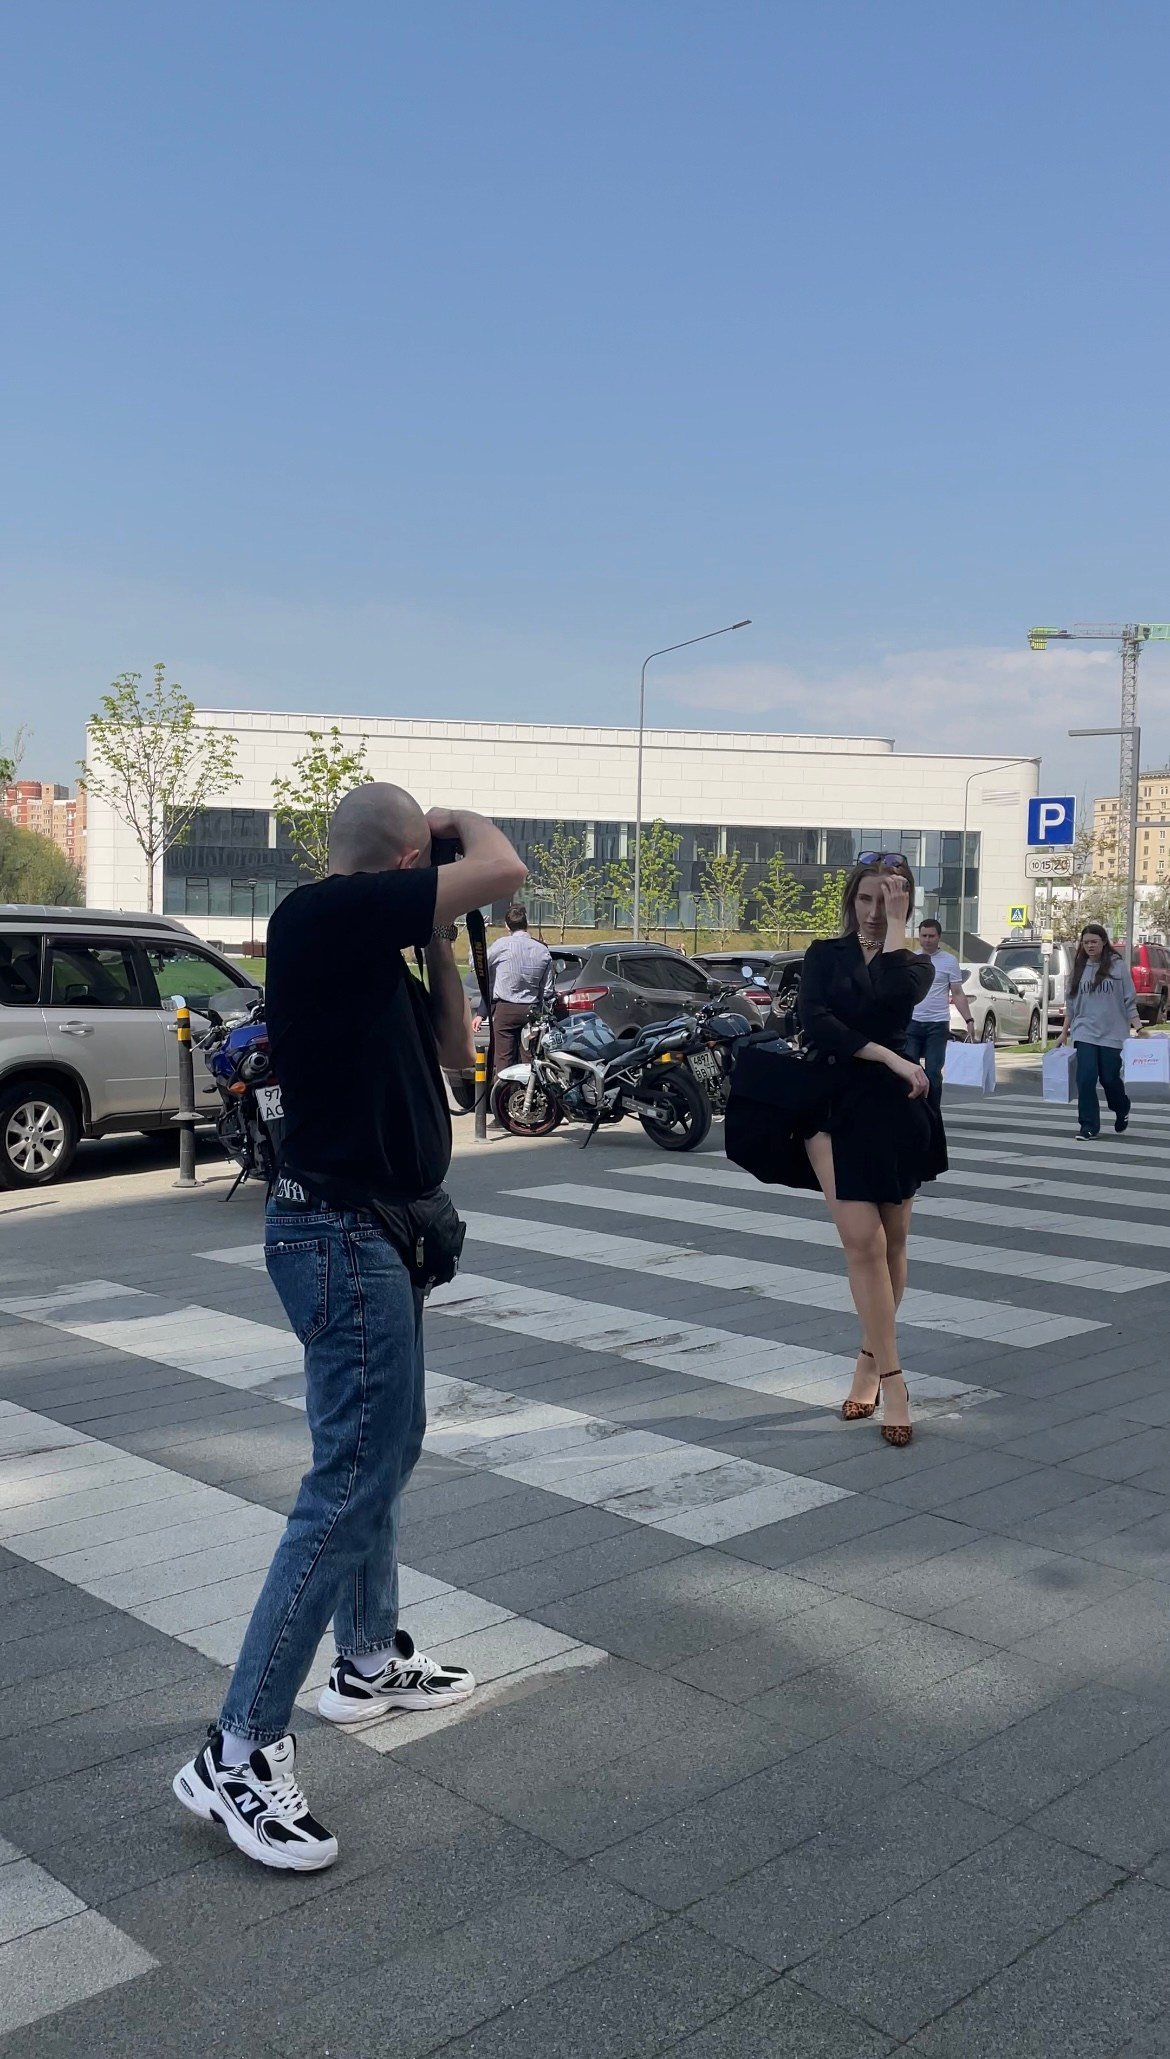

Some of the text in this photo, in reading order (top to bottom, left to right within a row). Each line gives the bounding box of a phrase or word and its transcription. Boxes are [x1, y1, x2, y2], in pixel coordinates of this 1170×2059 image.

[1038, 803, 1066, 840] P
[1031, 861, 1040, 870] 10
[1042, 860, 1051, 870] 15
[1079, 979, 1115, 994] LODON
[393, 1672, 416, 1688] N
[234, 1790, 261, 1814] N
